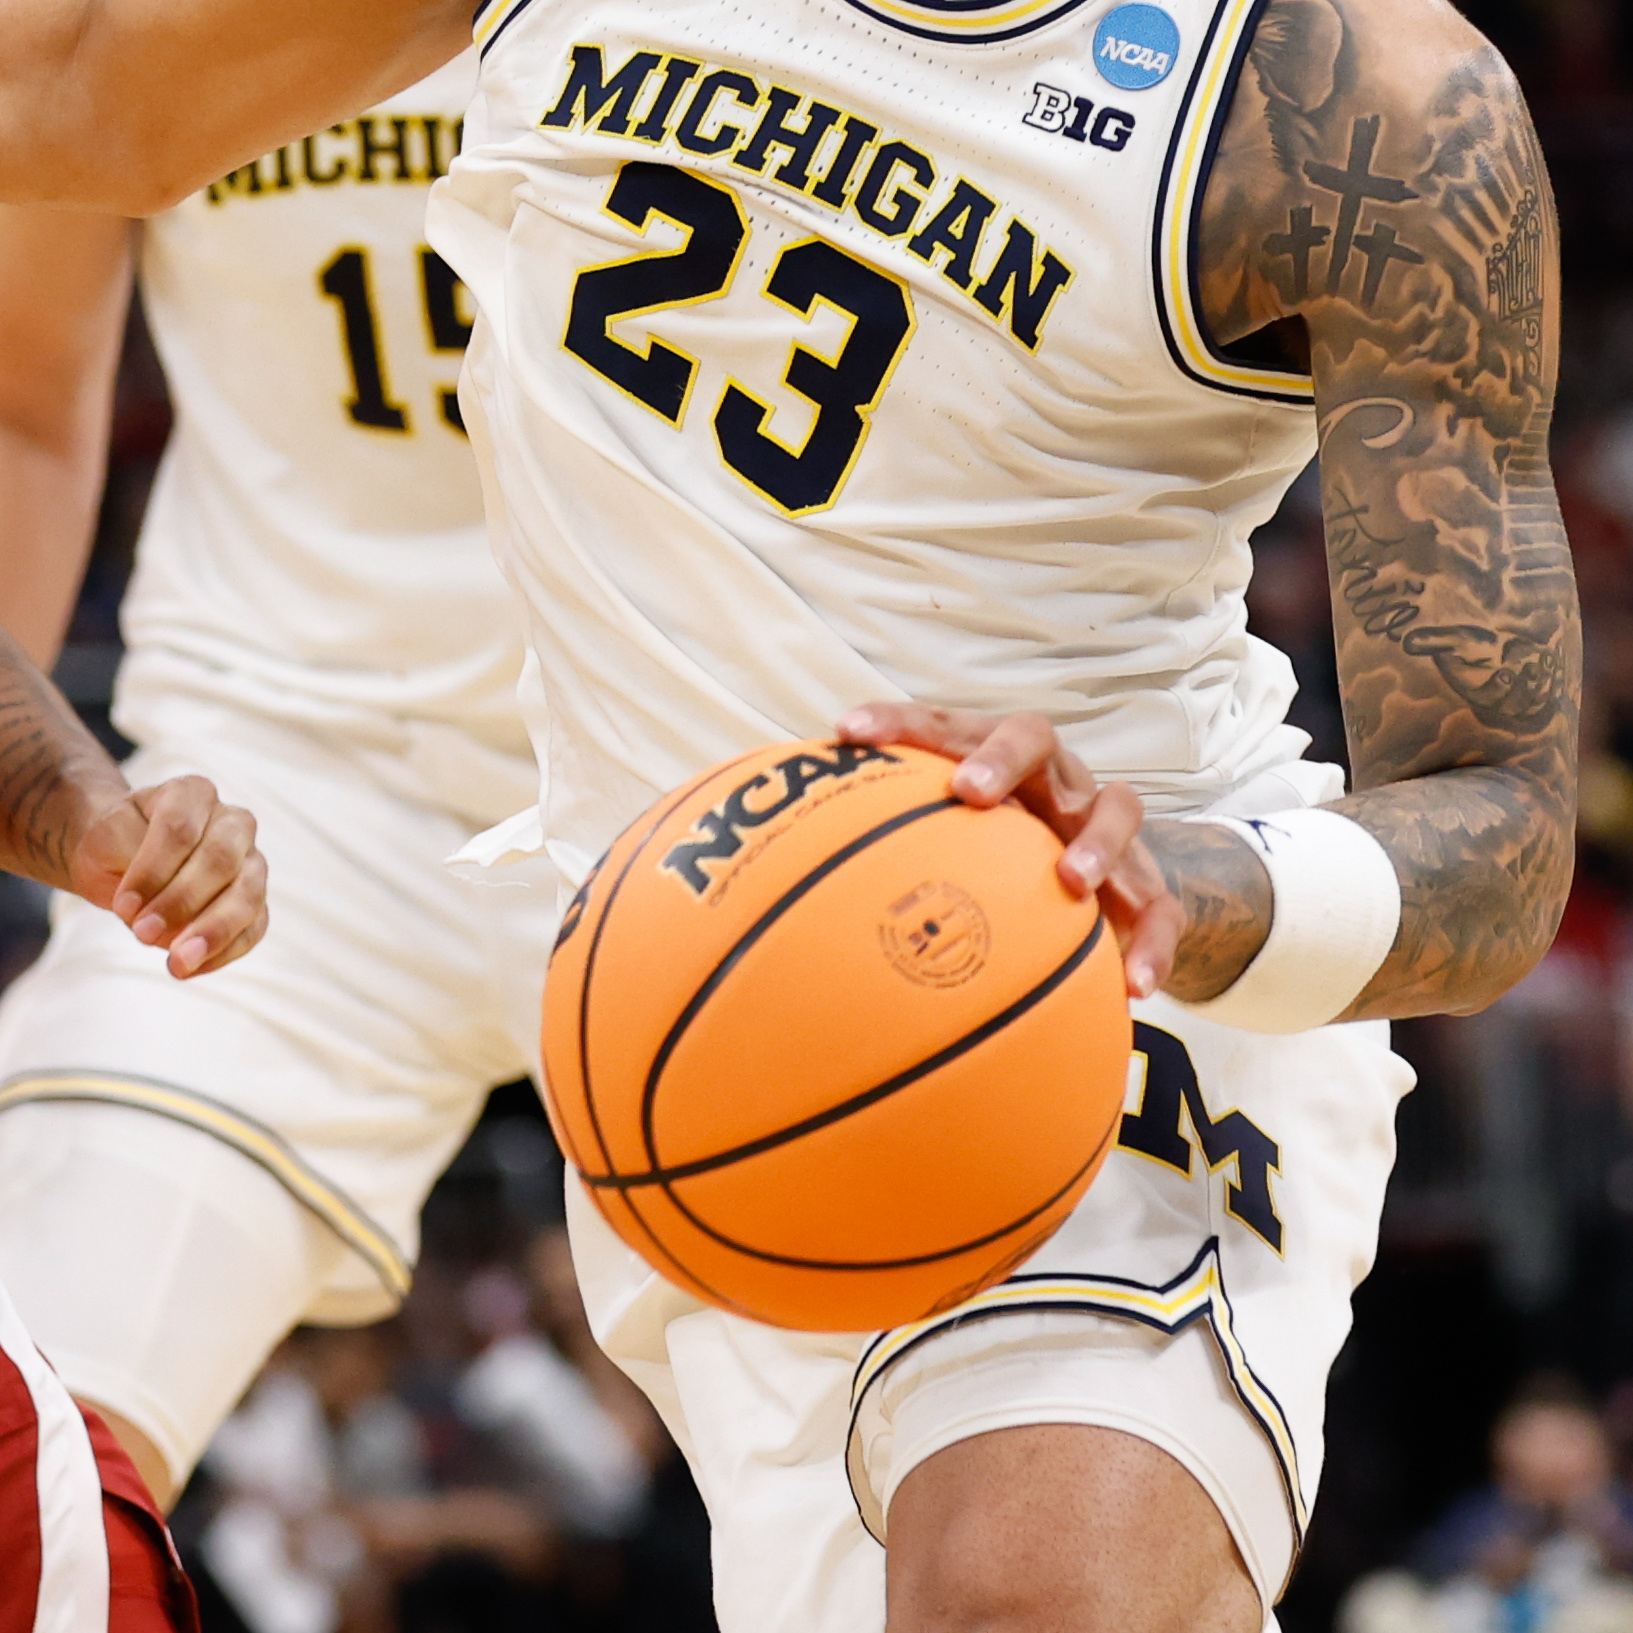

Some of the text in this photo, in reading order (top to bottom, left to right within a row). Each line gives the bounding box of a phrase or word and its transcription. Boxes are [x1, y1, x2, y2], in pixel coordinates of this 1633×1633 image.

[1099, 35, 1170, 75] NCAA
[536, 43, 1077, 357] MICHIGAN
[560, 158, 919, 519] 23
[659, 741, 903, 896] NCAA
[1112, 1018, 1286, 1262] M
